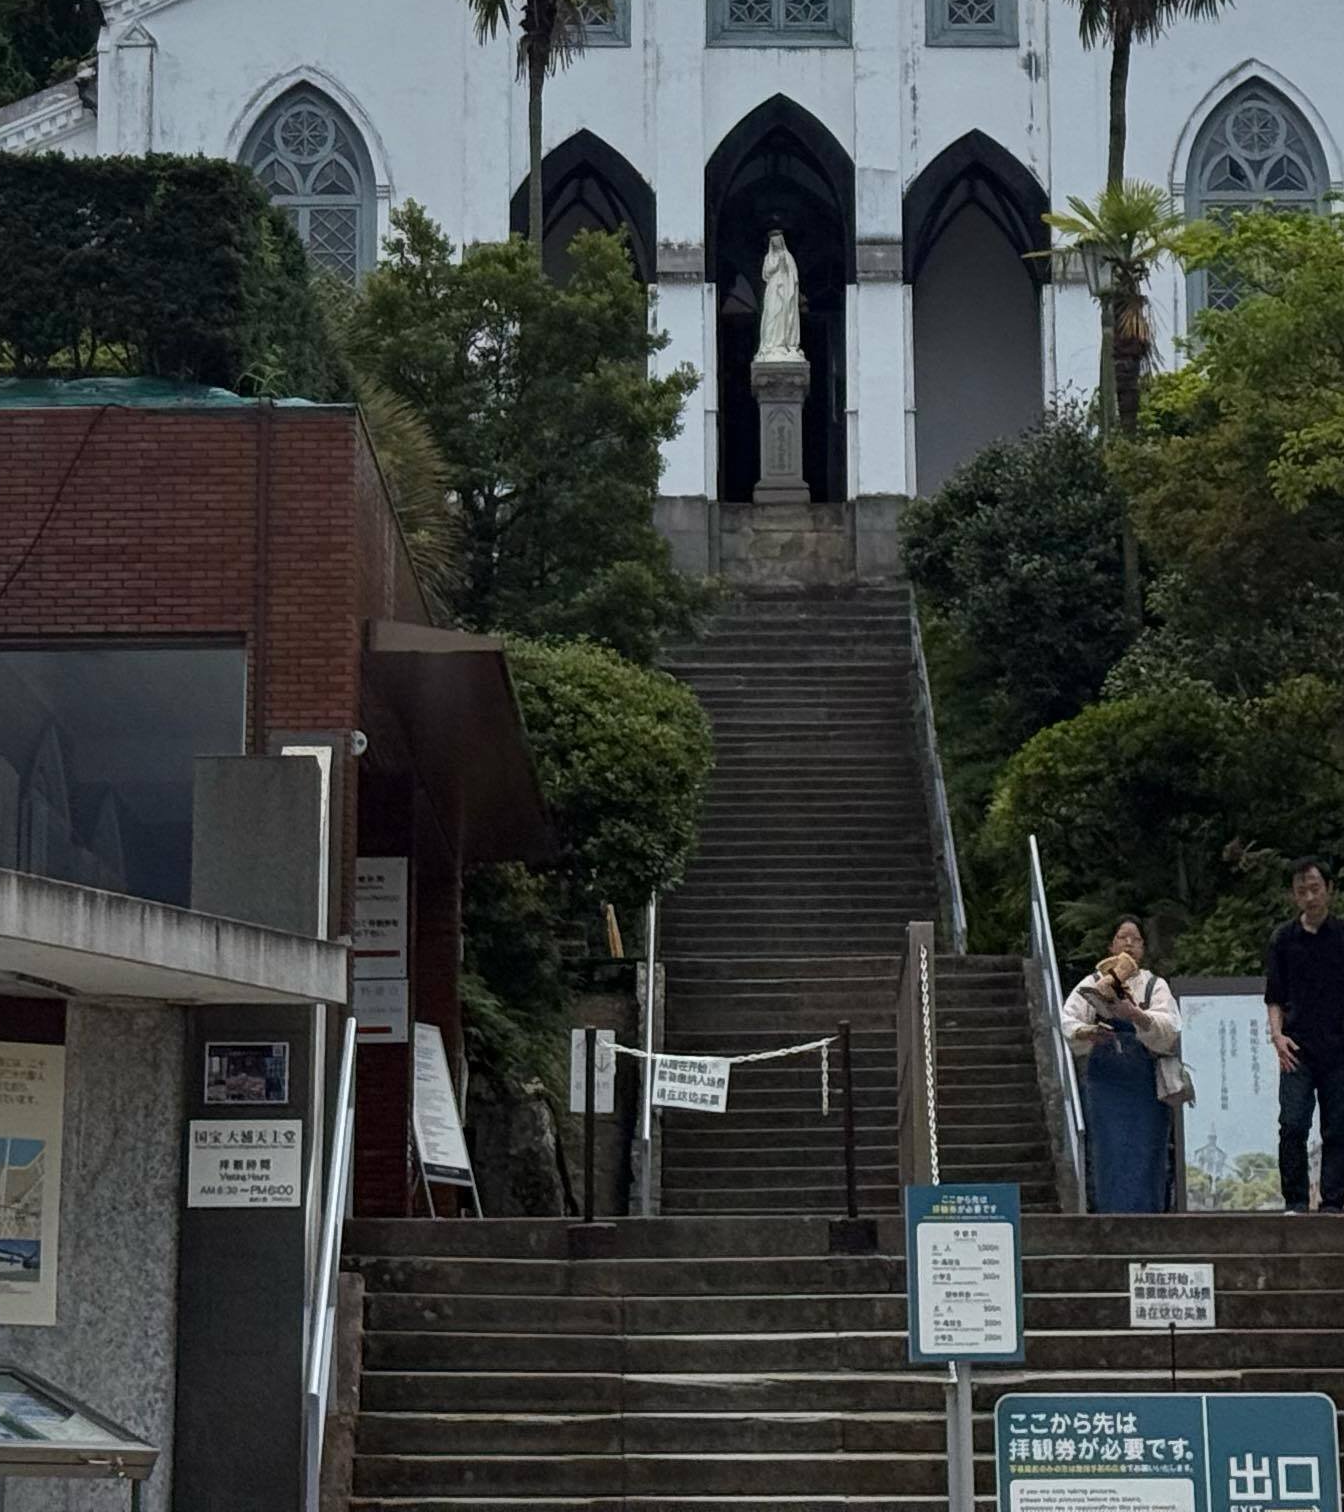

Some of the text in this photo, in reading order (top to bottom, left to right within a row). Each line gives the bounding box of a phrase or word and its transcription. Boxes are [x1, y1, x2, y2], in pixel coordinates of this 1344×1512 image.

[1009, 1413, 1137, 1434] ここから先は
[1008, 1438, 1194, 1461] 拝観券が必要です。
[1229, 1453, 1321, 1500] 出口
